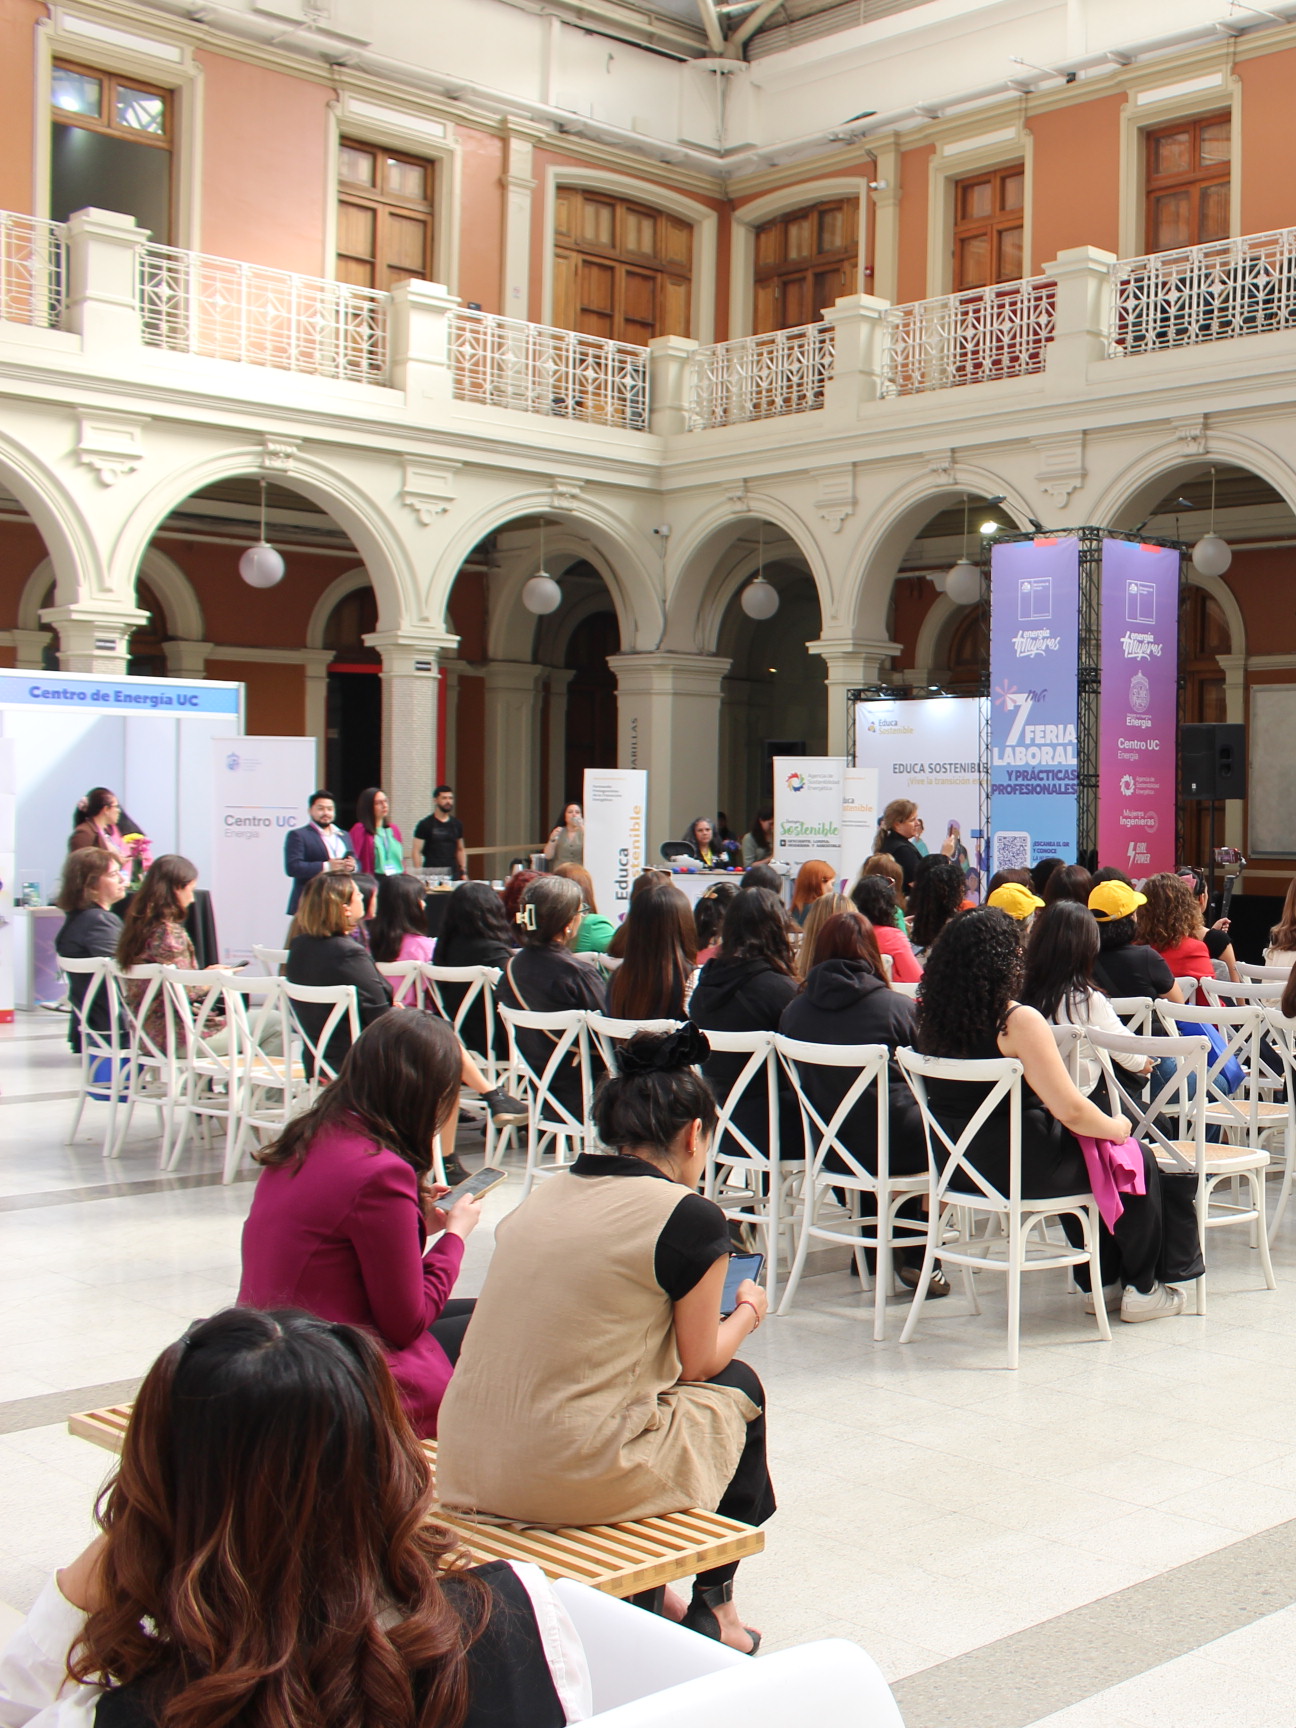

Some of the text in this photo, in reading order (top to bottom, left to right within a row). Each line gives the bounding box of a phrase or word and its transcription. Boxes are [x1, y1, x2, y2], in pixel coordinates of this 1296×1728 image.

[28, 686, 199, 707] Centro de Energía UC
[878, 719, 898, 727] Educa
[1126, 717, 1152, 728] Energía
[1025, 724, 1078, 744] FERIA
[1118, 738, 1160, 750] Centro UC
[992, 746, 1077, 765] LABORAL
[1118, 751, 1139, 761] Energía
[892, 763, 925, 774] EDUCA
[1006, 767, 1077, 781] Y PRÁCTICAS
[992, 783, 1078, 795] PROFESIONALES
[224, 814, 297, 827] Centro UC
[1120, 816, 1155, 827] Ingenieras
[780, 820, 839, 837] Sostenible
[629, 805, 642, 878] stenible
[615, 848, 629, 901] Educa
